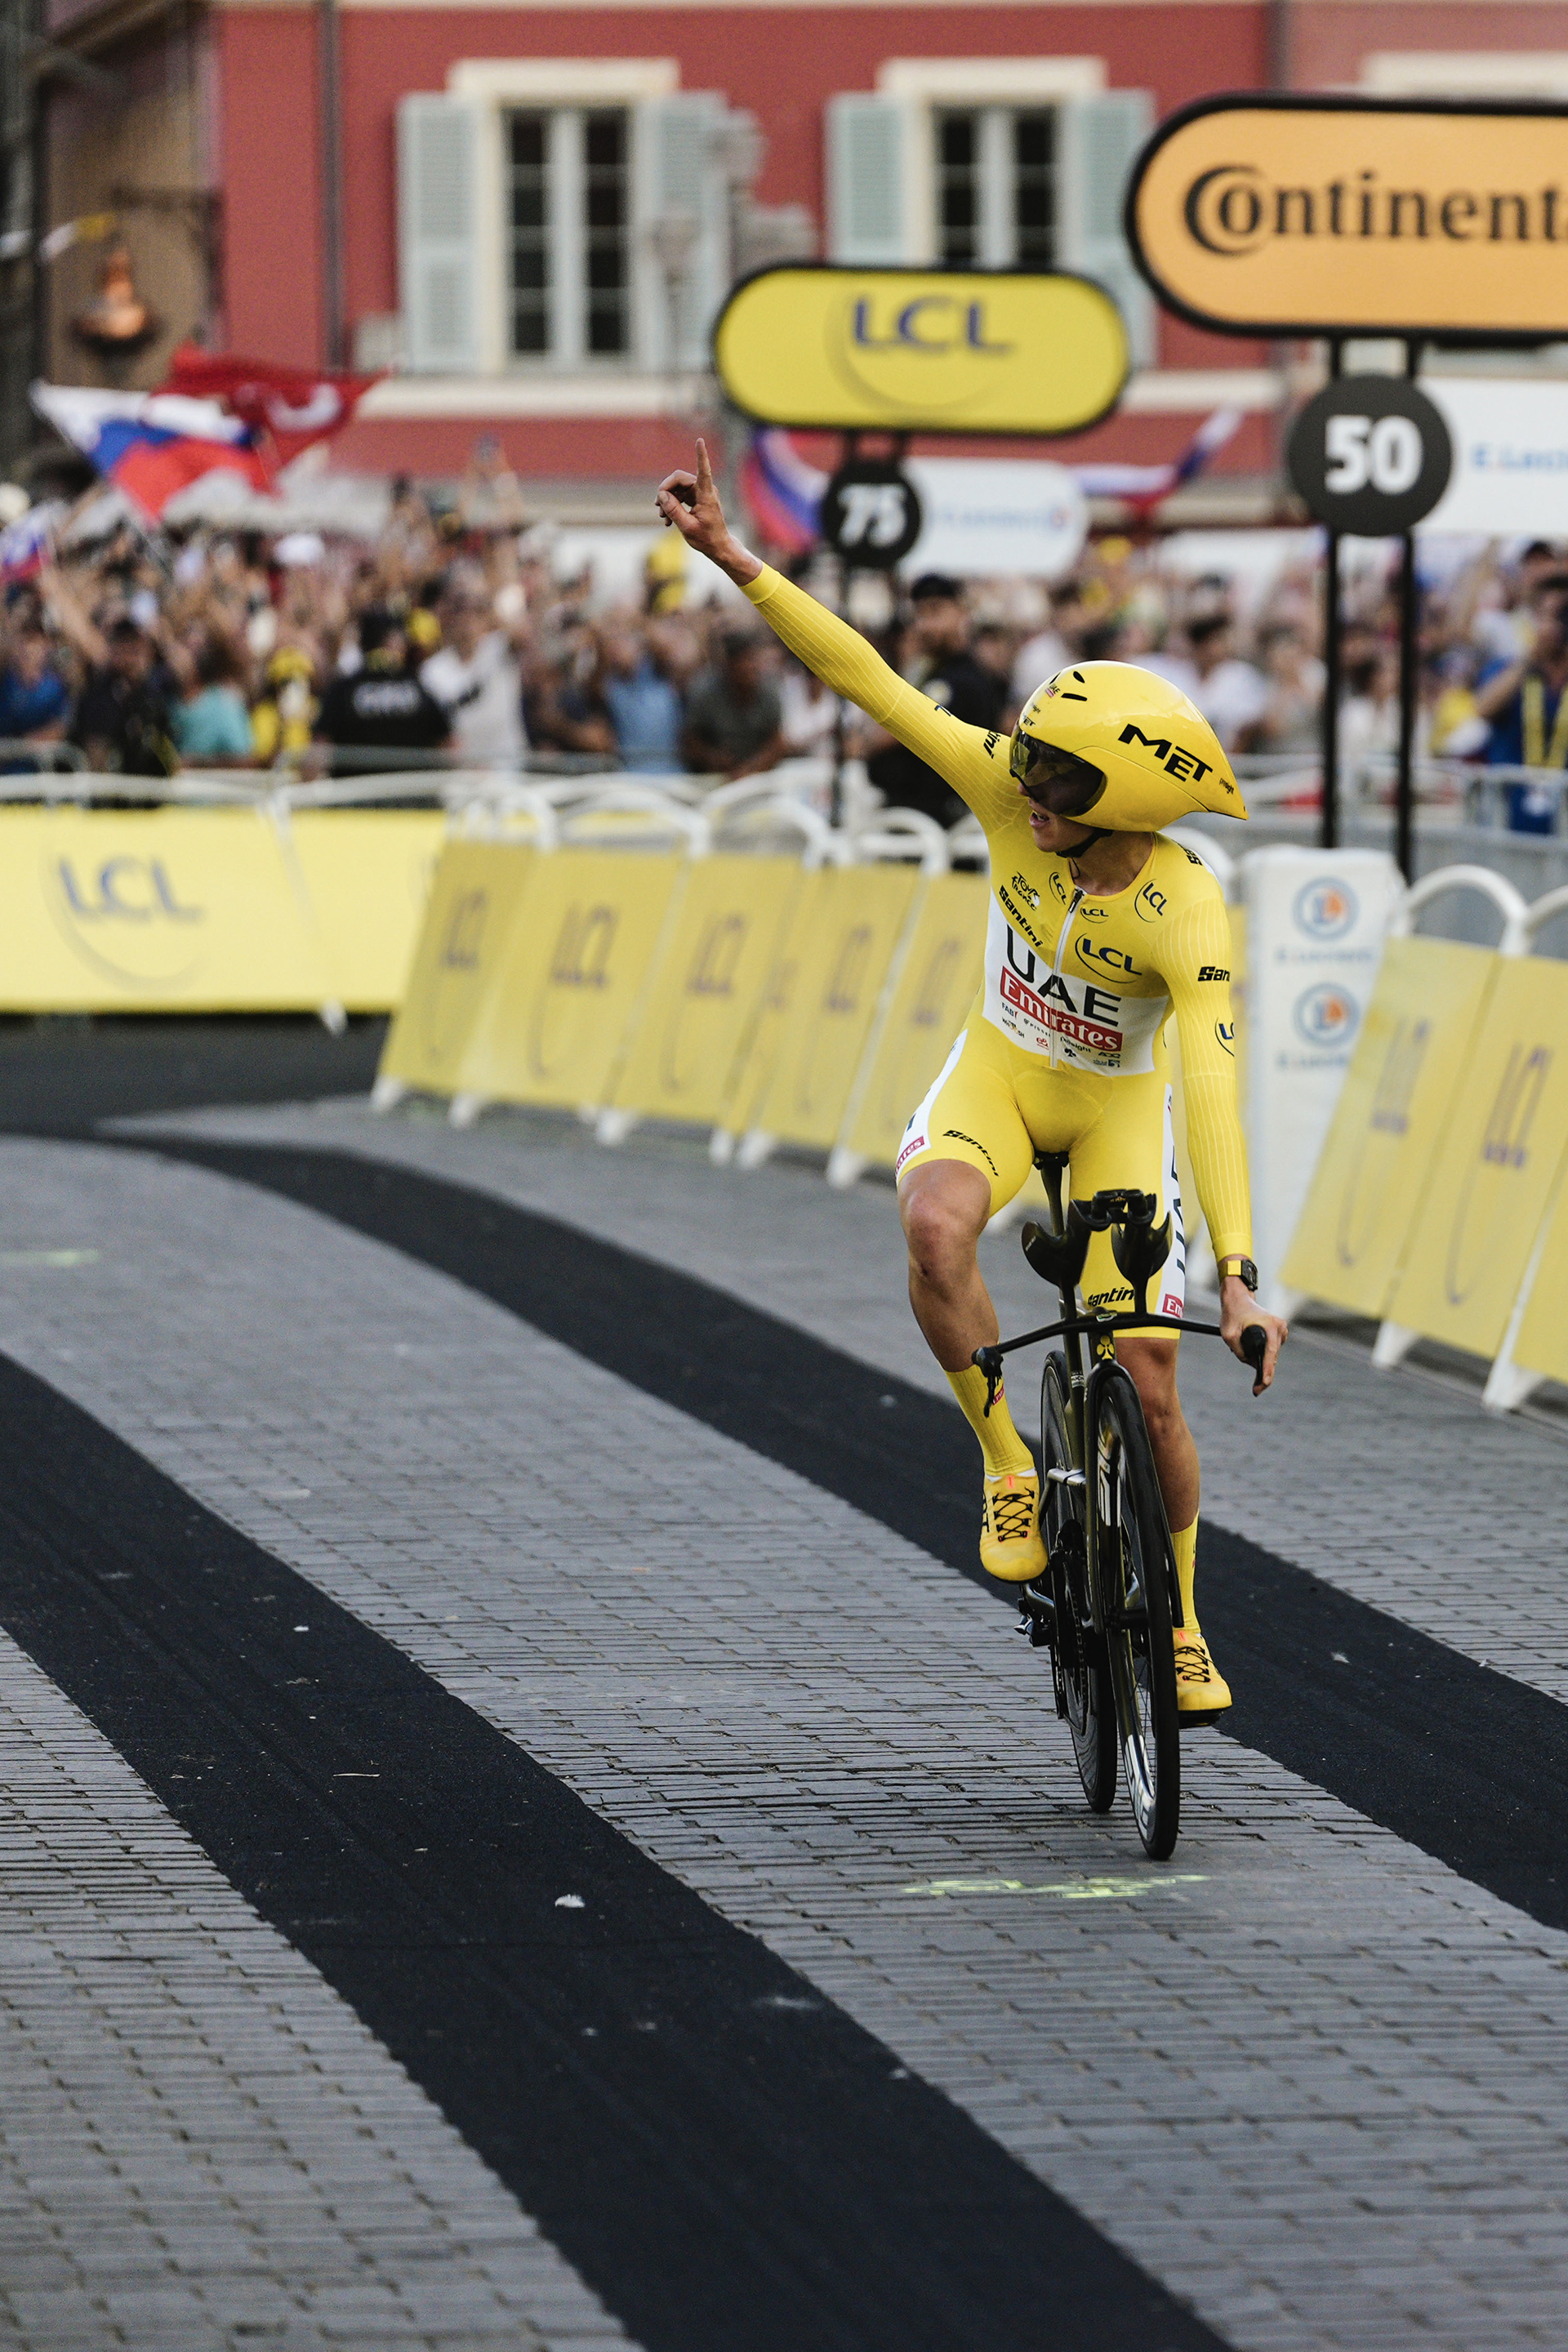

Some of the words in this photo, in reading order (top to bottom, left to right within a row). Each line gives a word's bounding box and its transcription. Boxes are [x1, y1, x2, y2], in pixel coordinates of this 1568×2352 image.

[1184, 164, 1568, 256] Continent
[849, 295, 1013, 354] LCL
[1325, 415, 1423, 492] 50
[836, 482, 907, 548] 75
[1118, 724, 1213, 782] MET
[59, 856, 204, 921] LCL
[1053, 874, 1067, 905] LCL
[1082, 908, 1109, 917] LCL
[1143, 882, 1167, 916] LCL
[1007, 924, 1122, 1027] UAE
[1082, 938, 1143, 976] LCL
[1004, 973, 1119, 1051] Emirates
